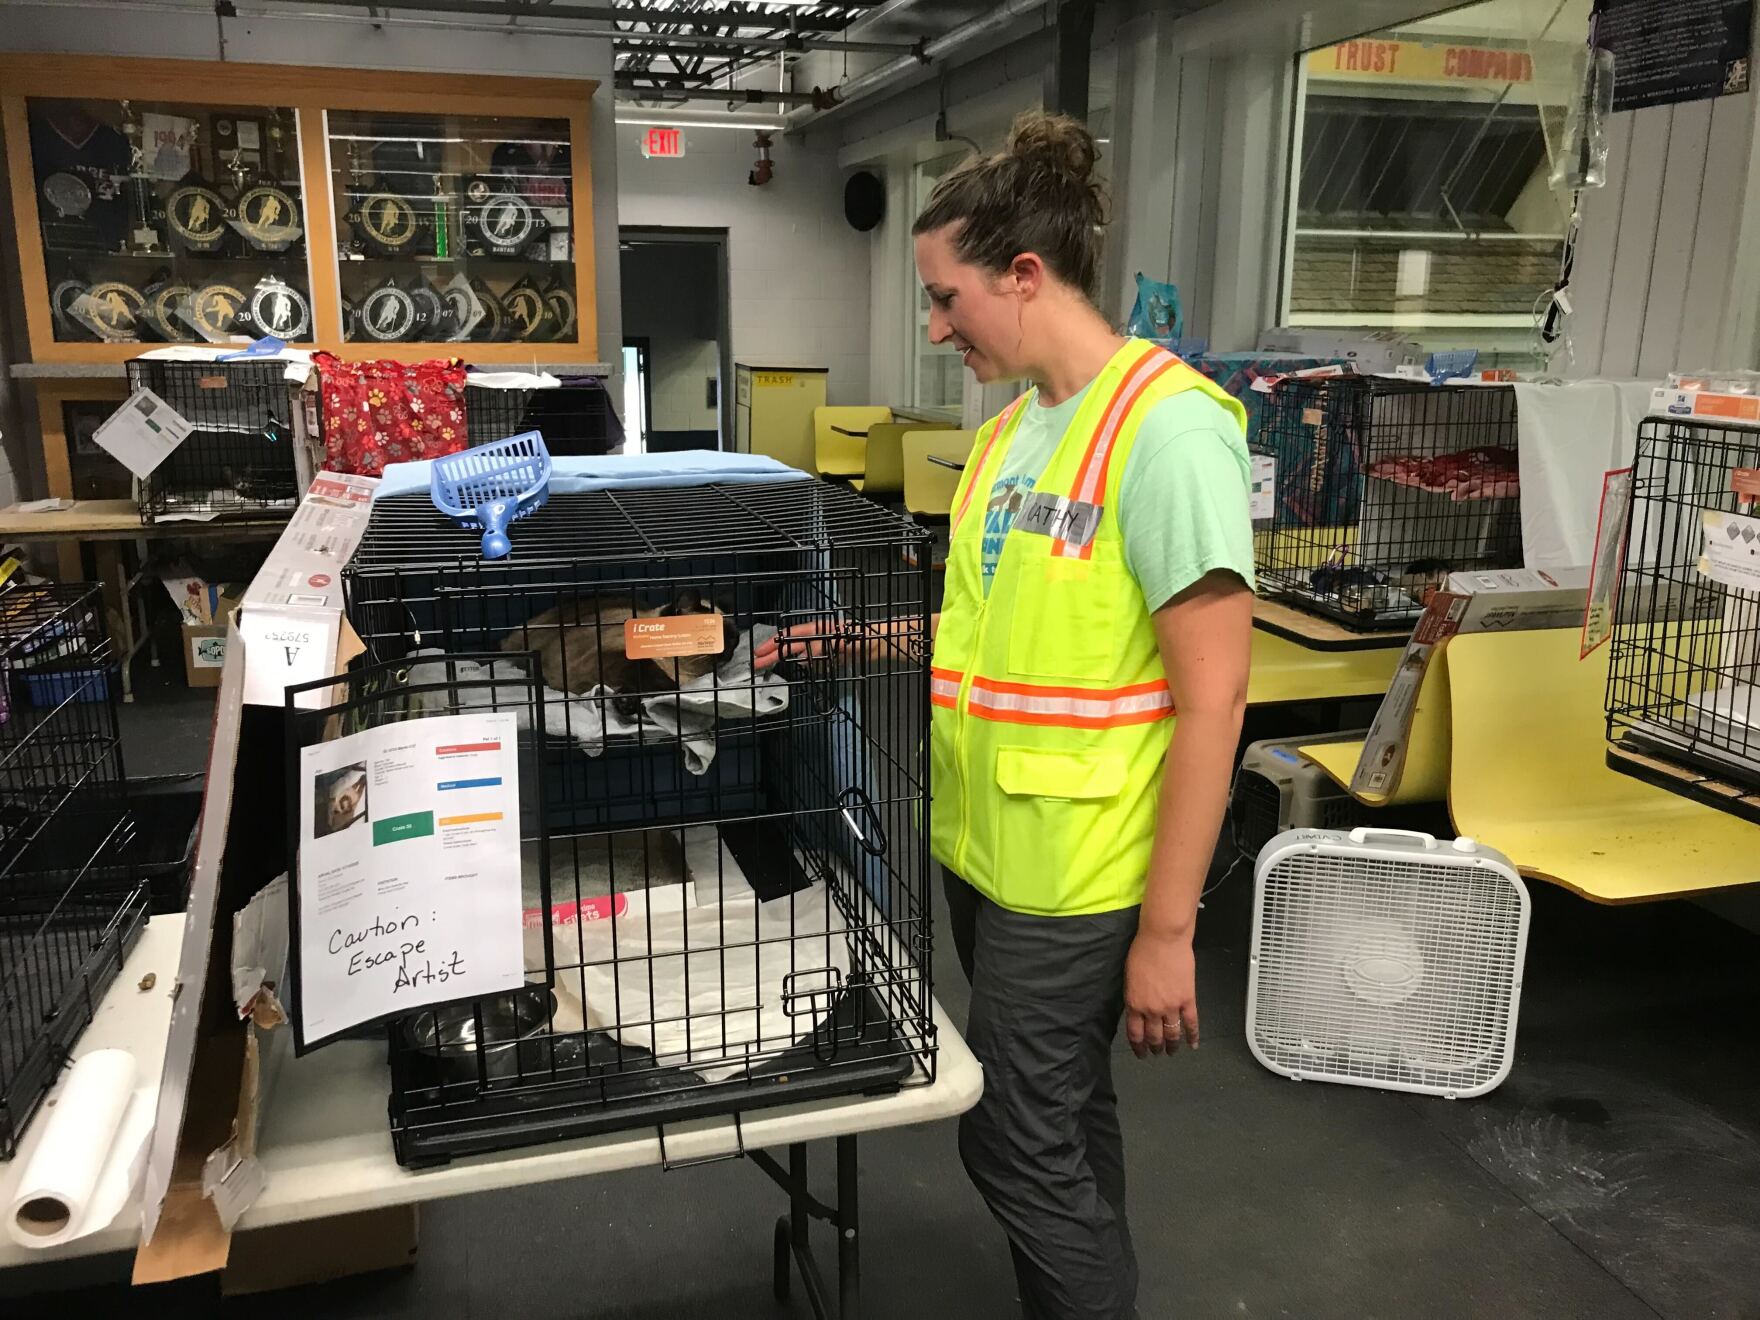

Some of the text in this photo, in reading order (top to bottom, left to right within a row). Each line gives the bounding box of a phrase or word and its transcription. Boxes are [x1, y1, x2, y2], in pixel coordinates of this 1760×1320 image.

[1335, 43, 1399, 73] TRUST
[648, 129, 680, 155] EXIT
[222, 208, 237, 218] 20
[466, 215, 479, 224] 20
[237, 311, 252, 322] 20
[416, 312, 427, 322] 12
[757, 375, 793, 384] TRASH
[284, 646, 300, 666] A
[348, 940, 426, 976] Escape
[393, 951, 466, 993] Artist
